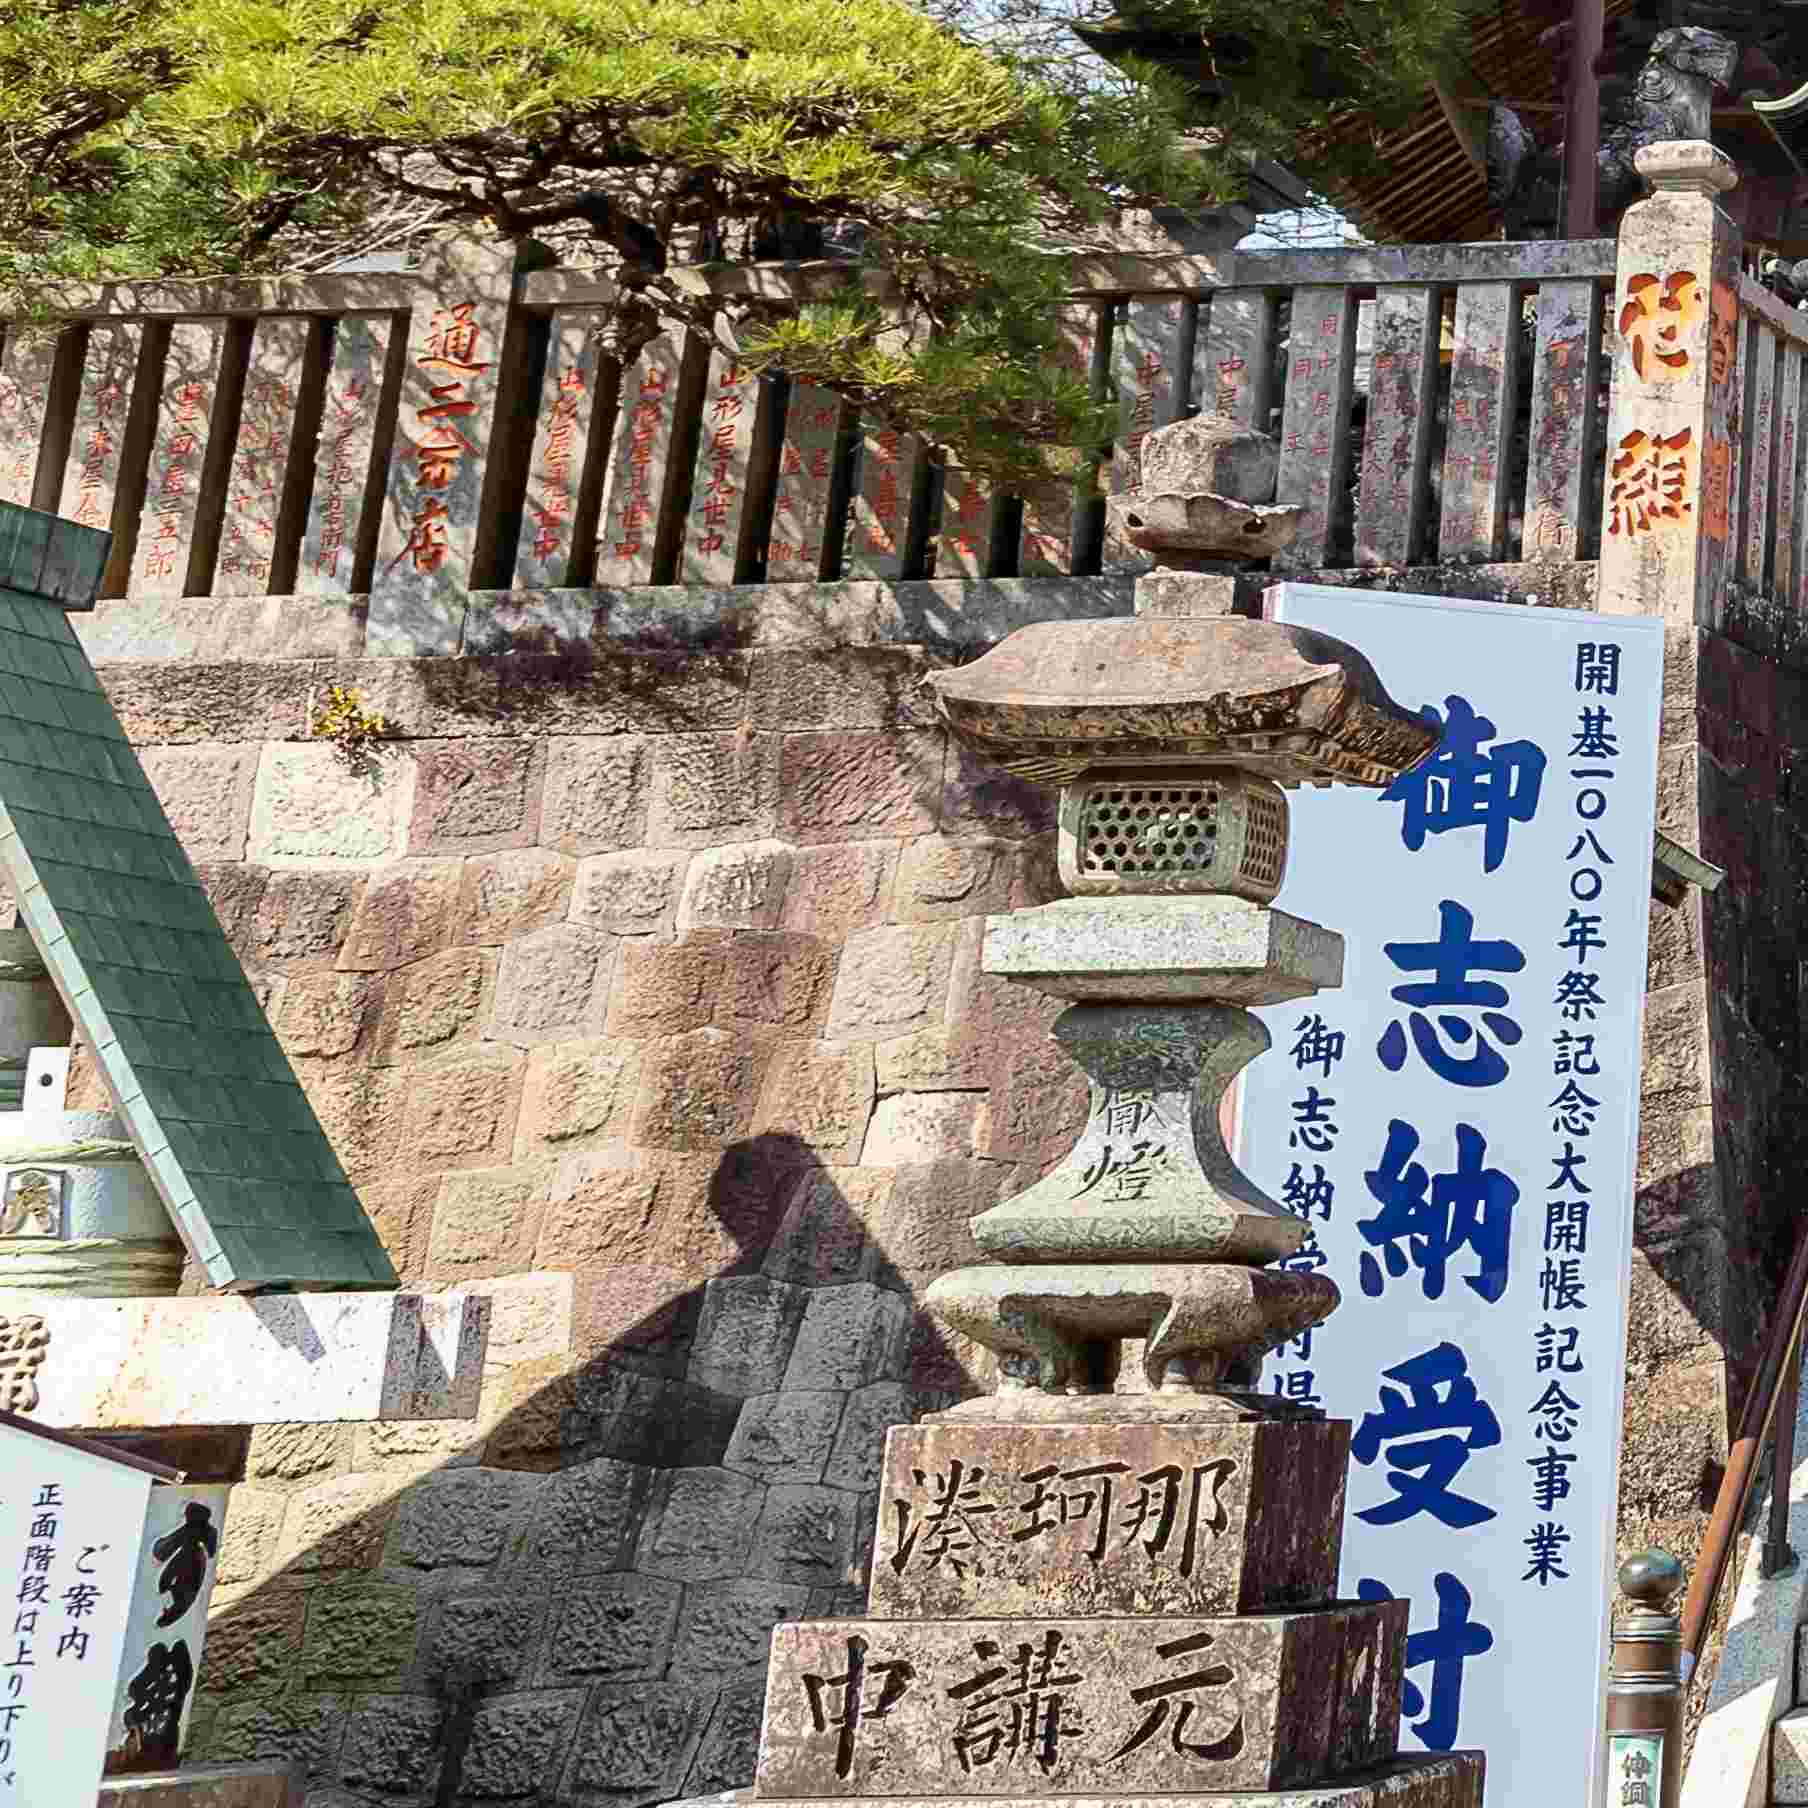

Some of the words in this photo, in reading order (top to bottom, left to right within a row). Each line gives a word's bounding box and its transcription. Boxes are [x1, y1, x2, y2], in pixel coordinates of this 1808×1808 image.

[1350, 694, 1548, 1751] 御志納受付
[56, 1544, 110, 1661] ご案内
